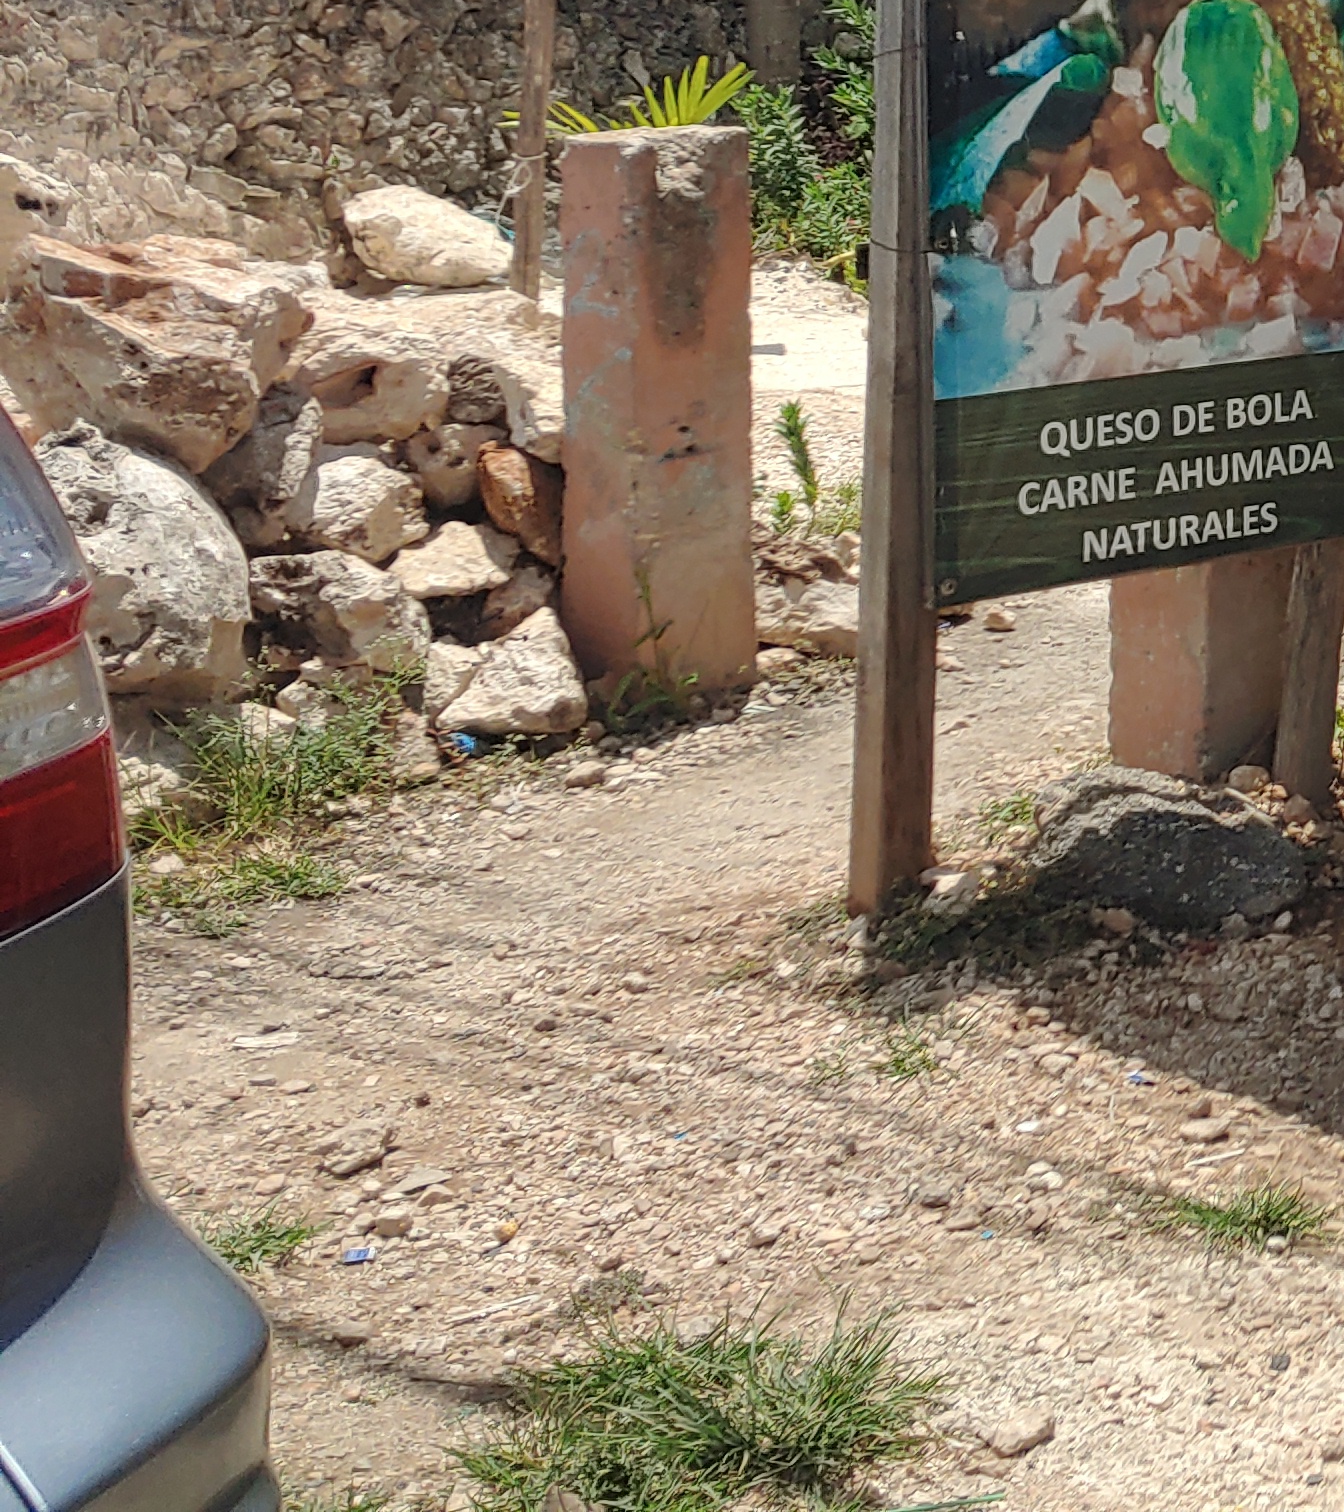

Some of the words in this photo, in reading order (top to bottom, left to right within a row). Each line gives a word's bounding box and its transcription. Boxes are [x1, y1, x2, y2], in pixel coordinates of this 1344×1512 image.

[1040, 408, 1160, 457] QUESO
[1172, 401, 1215, 438] DE
[1226, 390, 1314, 429] BOLA
[1017, 467, 1138, 516] CARNE
[1155, 440, 1335, 495] AHUMADA
[1081, 501, 1279, 562] NATURALES
